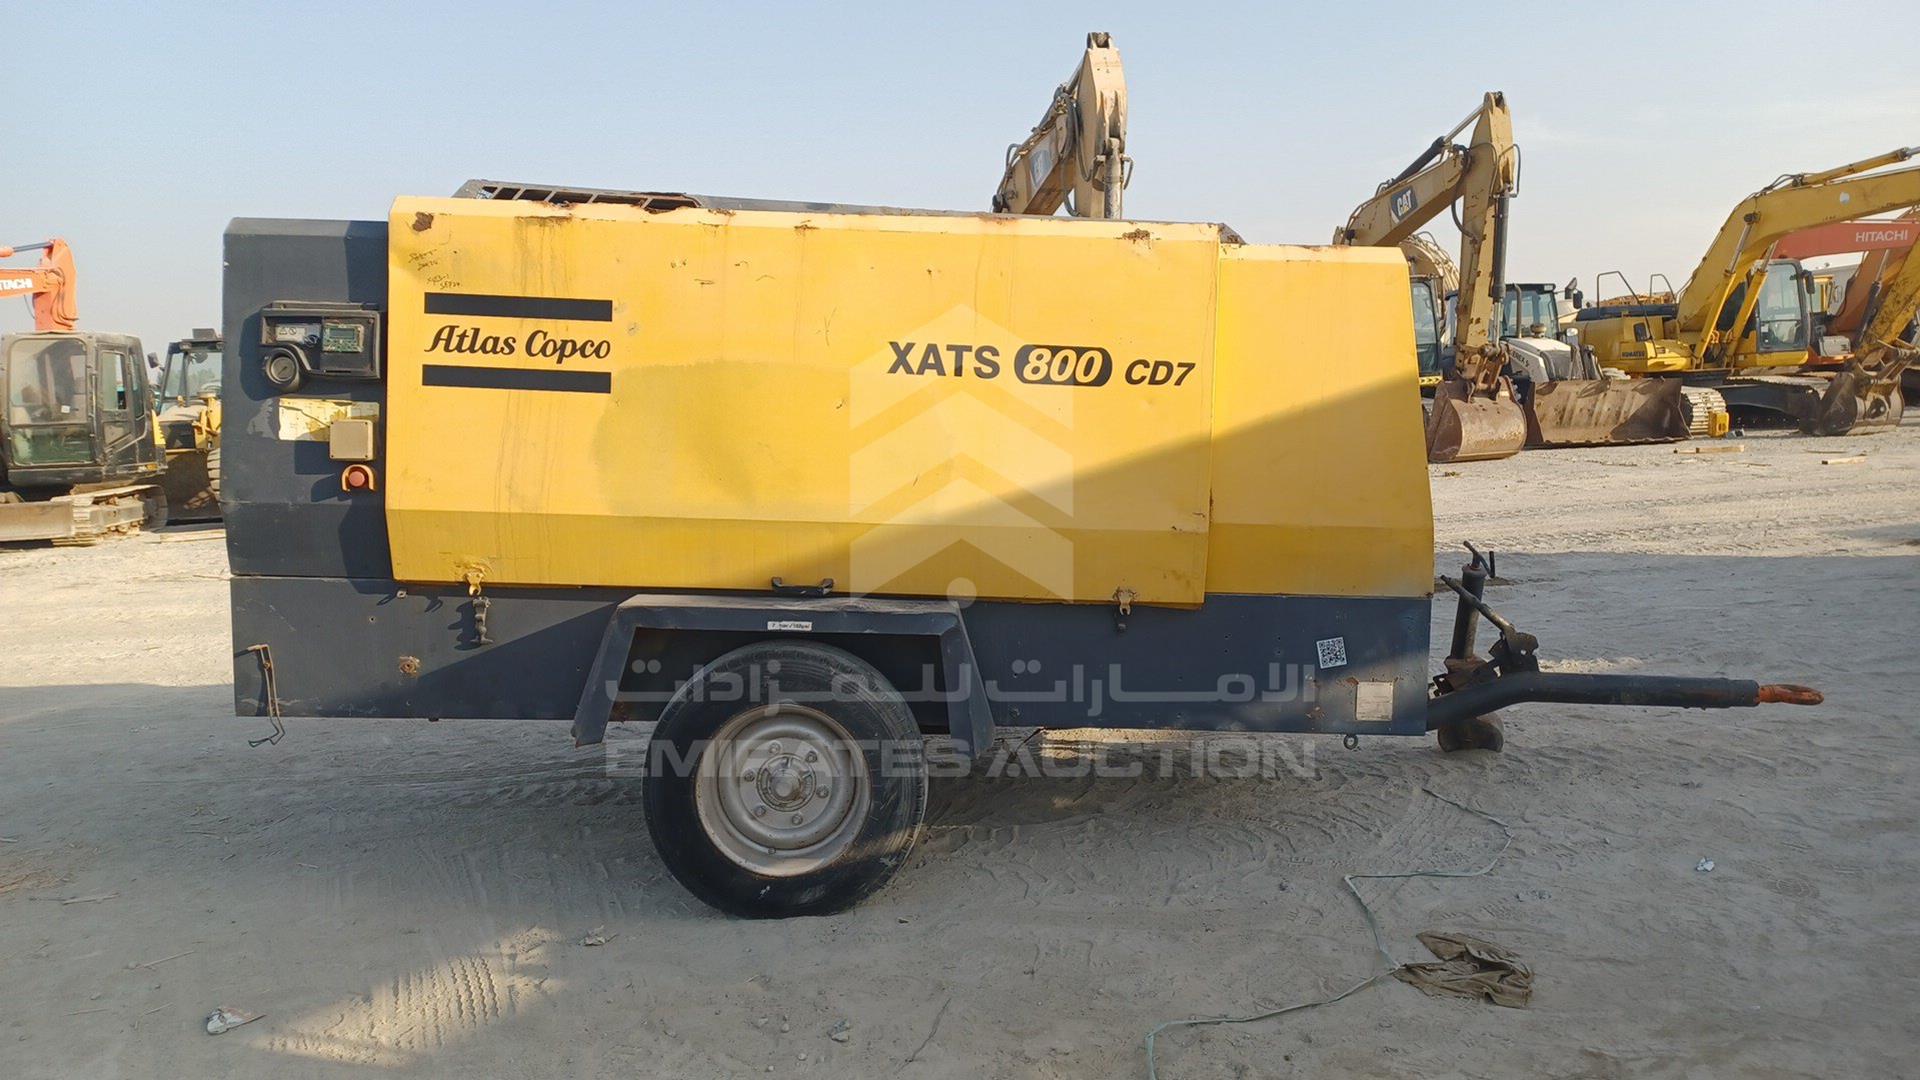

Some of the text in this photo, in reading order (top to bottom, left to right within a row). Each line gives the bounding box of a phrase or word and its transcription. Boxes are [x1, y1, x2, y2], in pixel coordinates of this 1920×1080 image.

[1397, 189, 1412, 216] CAT
[1854, 229, 1909, 242] HITACHI
[424, 325, 611, 364] Atlas Copco
[887, 341, 1195, 386] XATS 800 CD7
